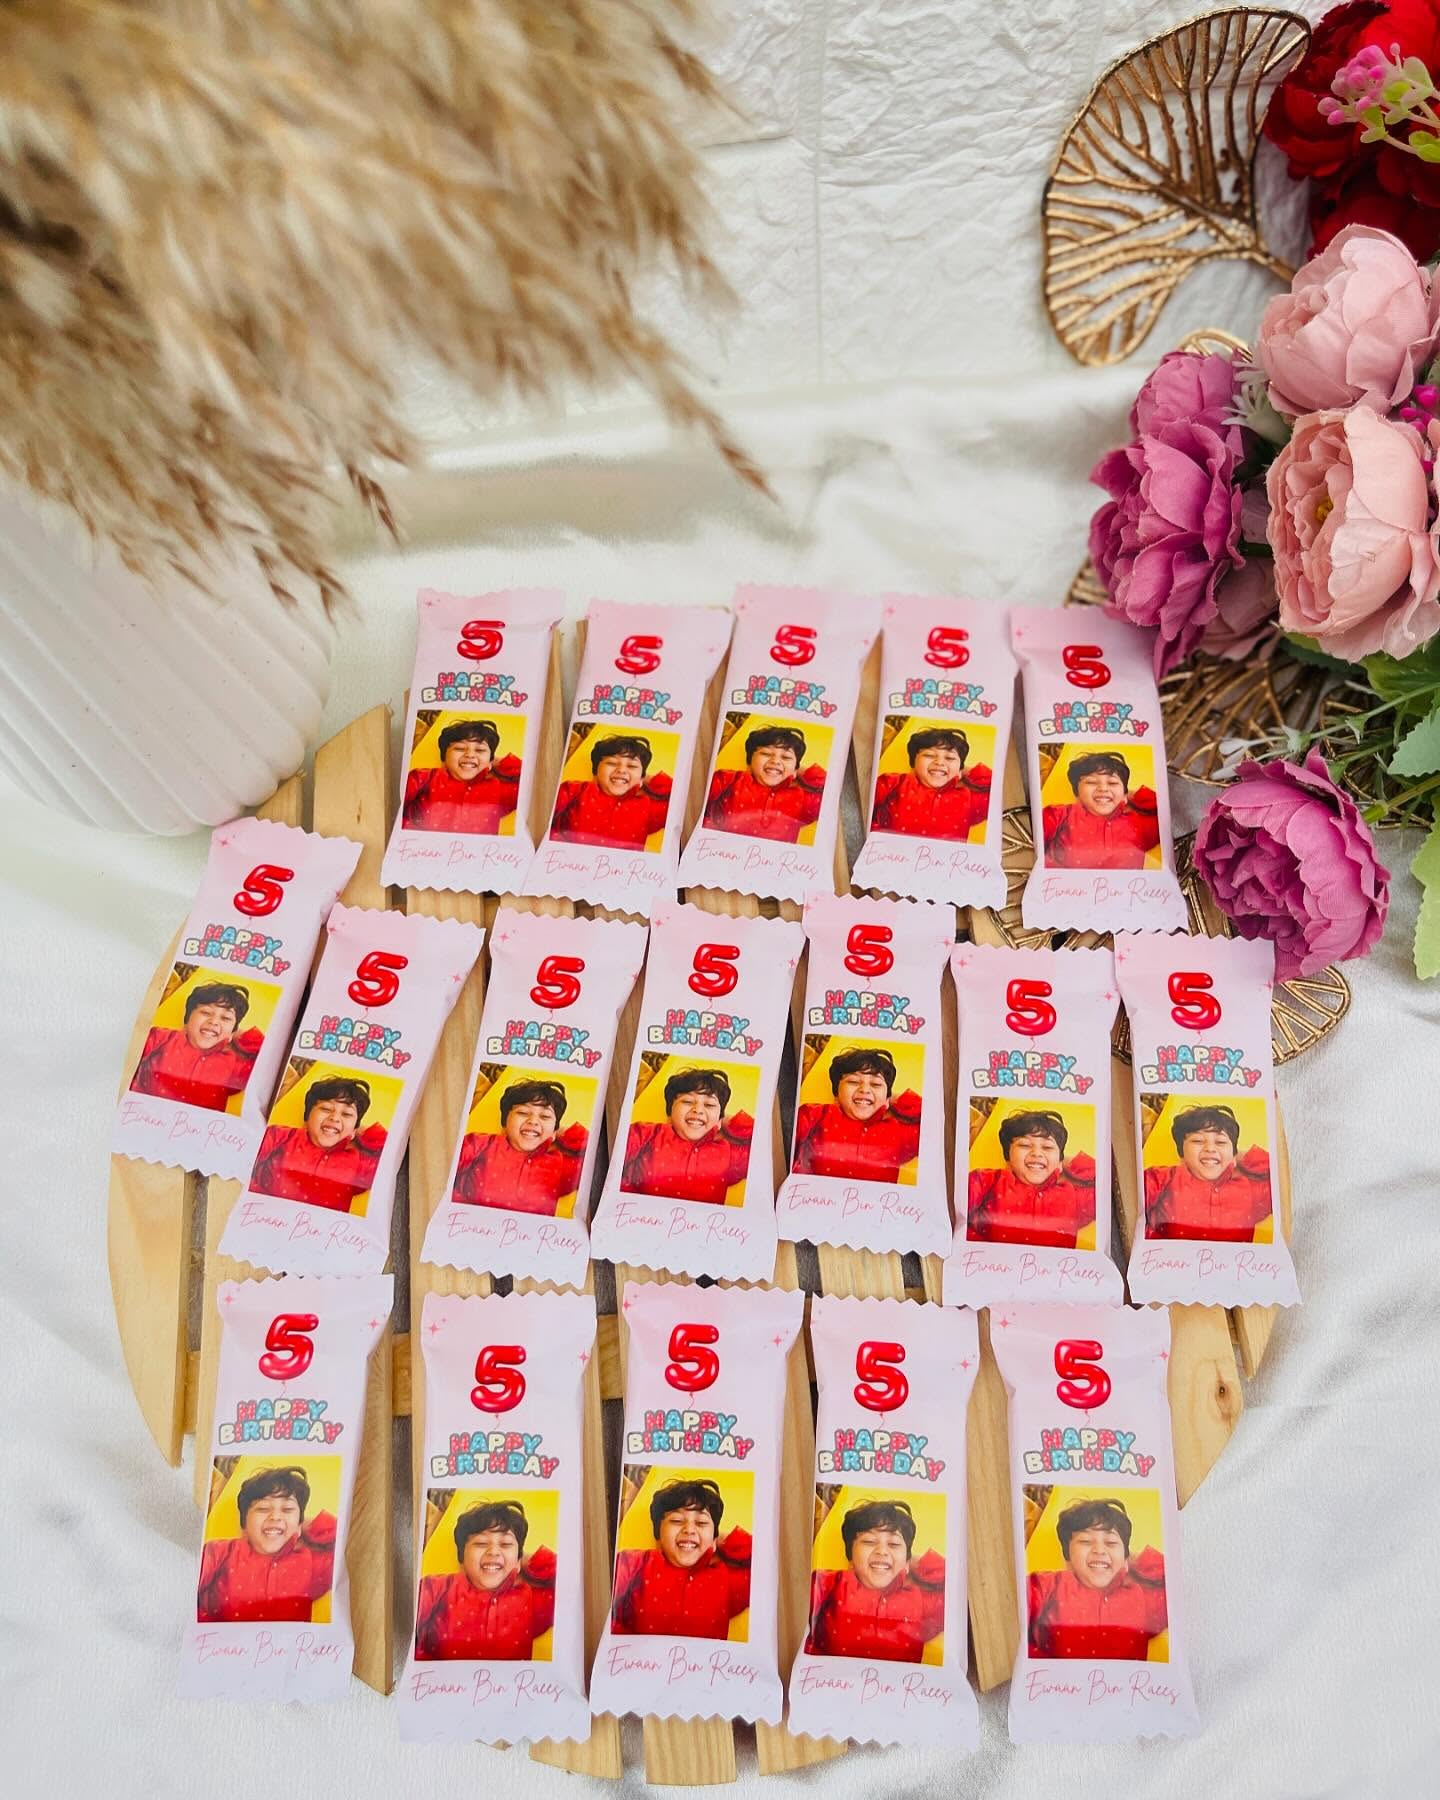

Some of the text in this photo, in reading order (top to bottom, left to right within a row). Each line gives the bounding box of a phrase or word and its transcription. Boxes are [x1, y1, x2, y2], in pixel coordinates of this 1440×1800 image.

[457, 620, 505, 660] 5
[615, 635, 663, 675] 5
[770, 624, 817, 666] 5
[924, 626, 970, 669] 5
[438, 672, 515, 690] HAPPY
[1062, 645, 1111, 689] 5
[421, 686, 528, 707] BIRTHDAY
[594, 685, 671, 706] HAPPY
[749, 675, 826, 699] HAPPY
[906, 678, 984, 699] HAPPY
[578, 699, 684, 725] BIRTHDAY
[731, 689, 837, 718] BIRTHDAY
[889, 692, 998, 718] BIRTHDAY
[1053, 701, 1133, 719] HAPPY
[1038, 716, 1149, 737] BIRTHDAY
[448, 840, 477, 867] Bin
[593, 855, 624, 881] Bin
[744, 845, 775, 871] Bin
[914, 845, 945, 873] Bin
[233, 864, 294, 917] 5
[1093, 877, 1123, 905] Bin
[204, 923, 282, 956] HAPPY
[844, 924, 894, 977] 5
[183, 938, 290, 977] BIRTHDAY
[688, 943, 740, 997] 5
[348, 951, 409, 1007] 5
[530, 955, 585, 1009] 5
[825, 989, 910, 1013] HAPPY
[1005, 979, 1057, 1036] 5
[1168, 972, 1222, 1030] 5
[320, 1015, 402, 1047] HAPPY
[506, 1020, 589, 1046] HAPPY
[666, 1009, 750, 1034] HAPPY
[809, 1005, 925, 1035] BIRTHDAY
[299, 1030, 411, 1069] BIRTHDAY
[486, 1035, 602, 1069] BIRTHDAY
[647, 1024, 763, 1056] BIRTHDAY
[989, 1050, 1077, 1073] HAPPY
[1157, 1045, 1244, 1066] HAPPY
[971, 1067, 1093, 1094] BIRTHDAY
[1140, 1062, 1262, 1088] BIRTHDAY
[169, 1111, 201, 1141] Bin
[842, 1187, 874, 1220] Bin
[288, 1211, 321, 1241] Bin
[499, 1218, 530, 1249] Bin
[668, 1207, 701, 1239] Bin
[1019, 1252, 1051, 1285] Bin
[1197, 1248, 1228, 1279] Bin
[259, 1313, 319, 1380] 5
[664, 1323, 719, 1392] 5
[470, 1345, 526, 1413] 5
[853, 1341, 909, 1411] 5
[1054, 1339, 1111, 1409] 5
[237, 1398, 328, 1420] HAPPY
[644, 1409, 737, 1435] HAPPY
[219, 1418, 344, 1445] BIRTHDAY
[449, 1431, 542, 1455] HAPPY
[627, 1430, 754, 1459] BIRTHDAY
[834, 1429, 928, 1456] HAPPY
[1041, 1427, 1136, 1452] HAPPY
[430, 1451, 559, 1479] BIRTHDAY
[818, 1450, 945, 1481] BIRTHDAY
[1023, 1449, 1156, 1477] BIRTHDAY
[254, 1630, 287, 1669] Bin
[668, 1645, 703, 1685] Bin
[472, 1668, 507, 1708] Bin
[861, 1667, 896, 1705] Bin
[1087, 1668, 1122, 1706] Bin
